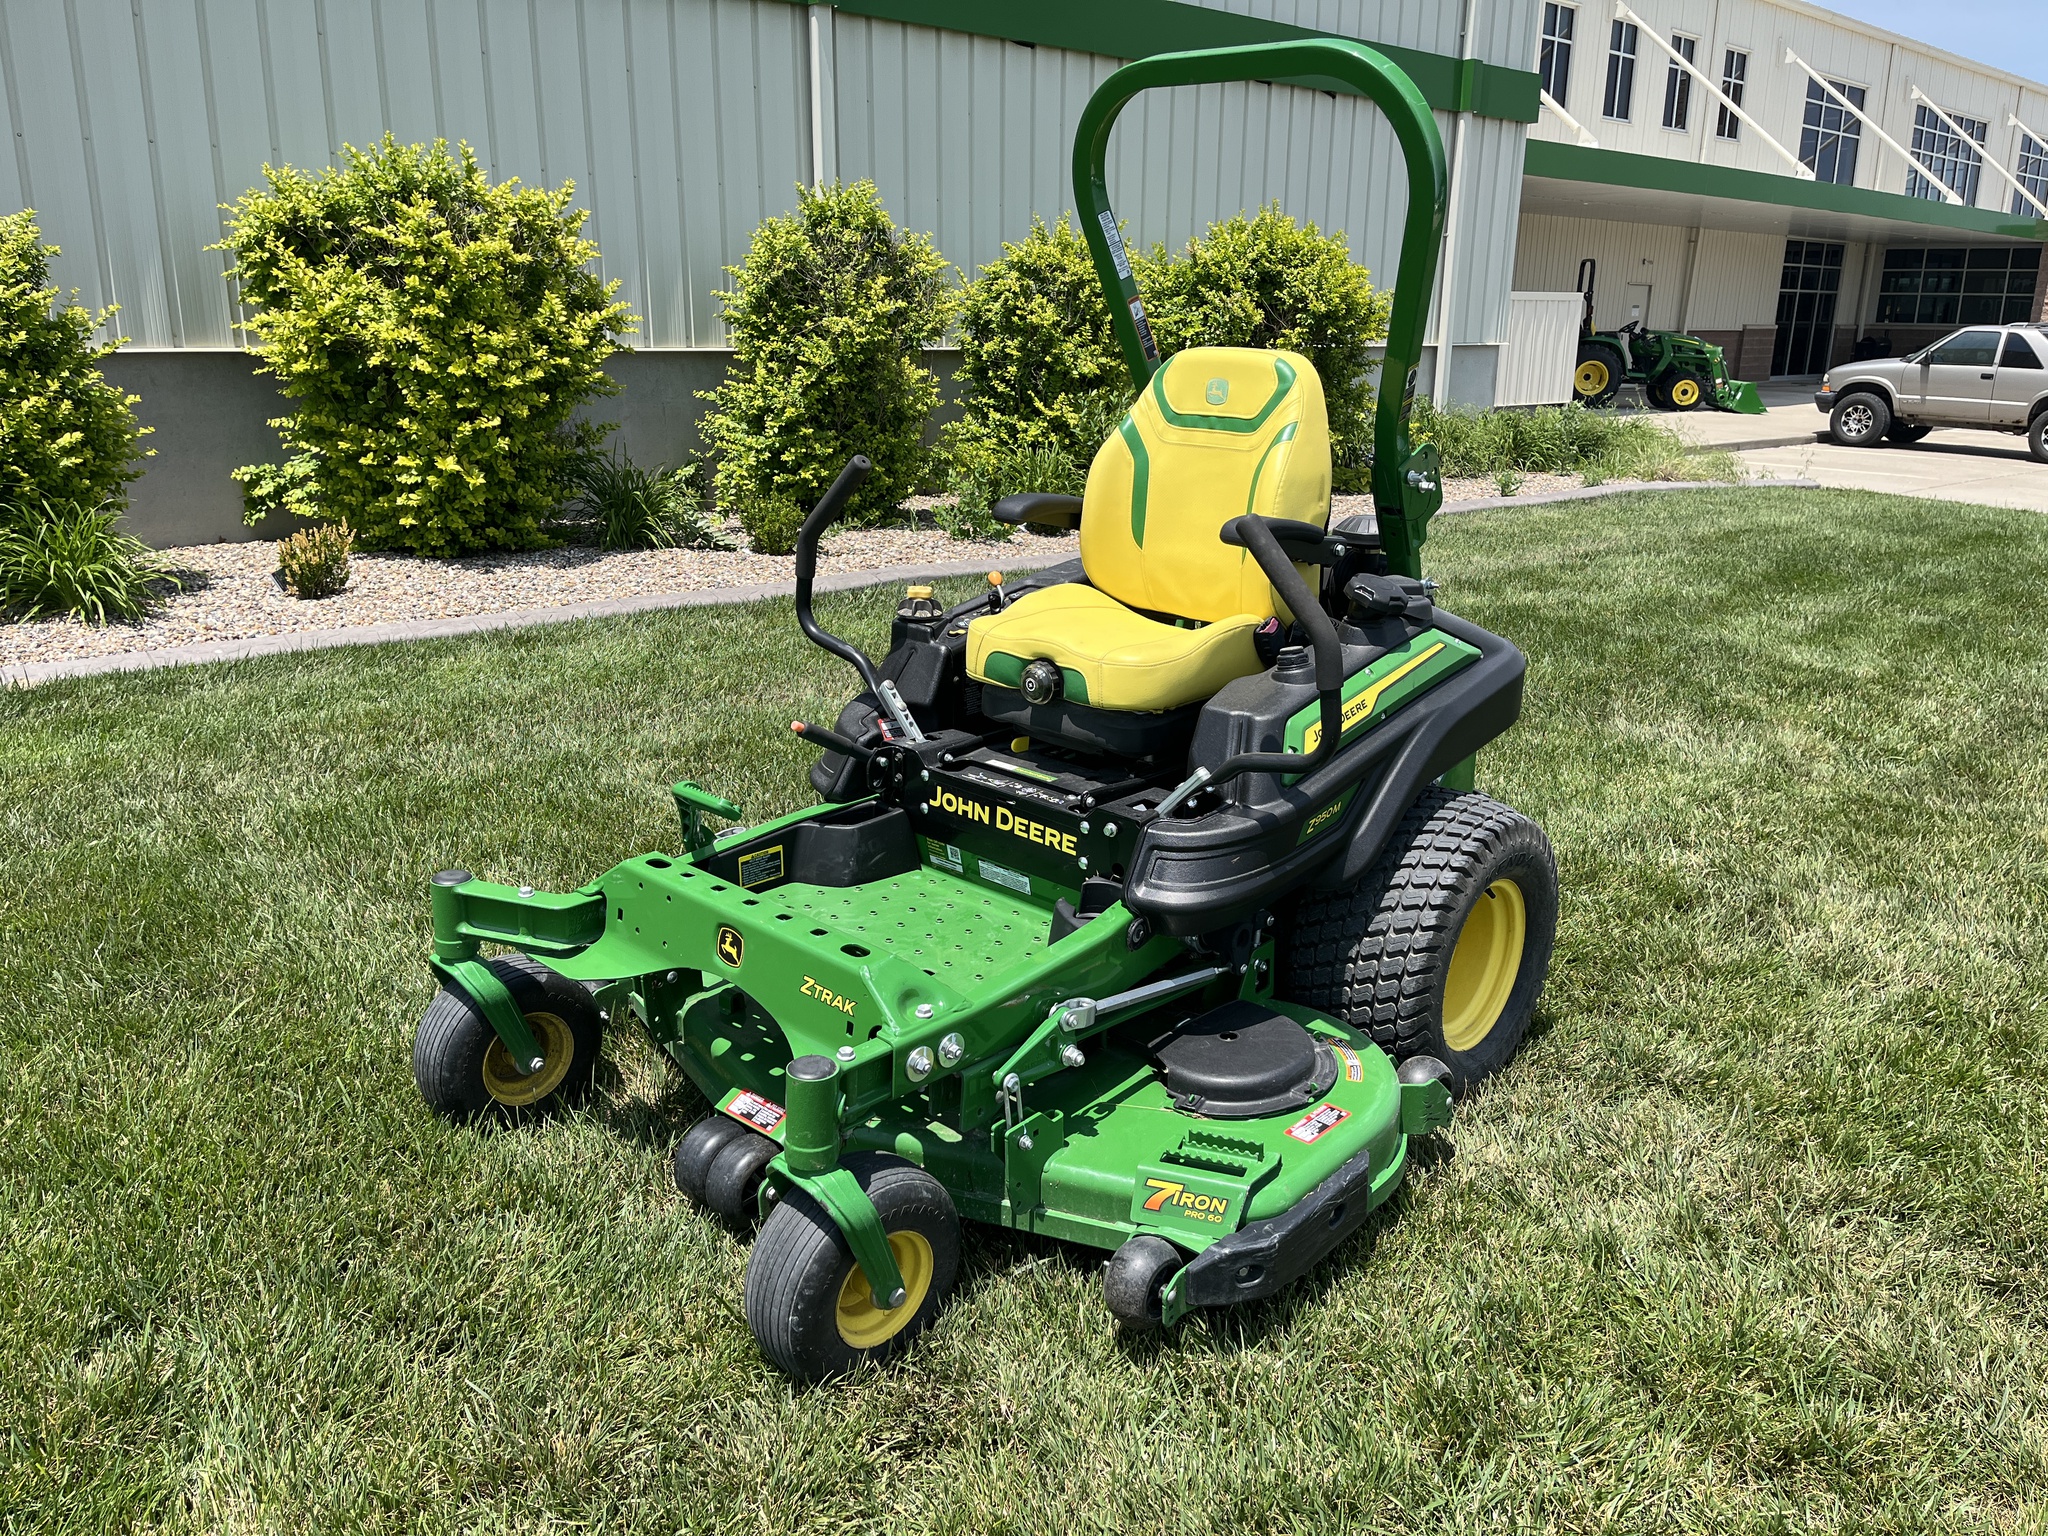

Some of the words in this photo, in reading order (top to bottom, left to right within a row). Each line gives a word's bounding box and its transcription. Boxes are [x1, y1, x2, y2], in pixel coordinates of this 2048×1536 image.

[929, 785, 990, 825] JOHN
[995, 805, 1078, 856] DEERE
[1306, 801, 1342, 835] Z950M
[799, 974, 858, 1018] ZTRAK
[1184, 1209, 1205, 1220] PRO
[1207, 1214, 1223, 1223] 60
